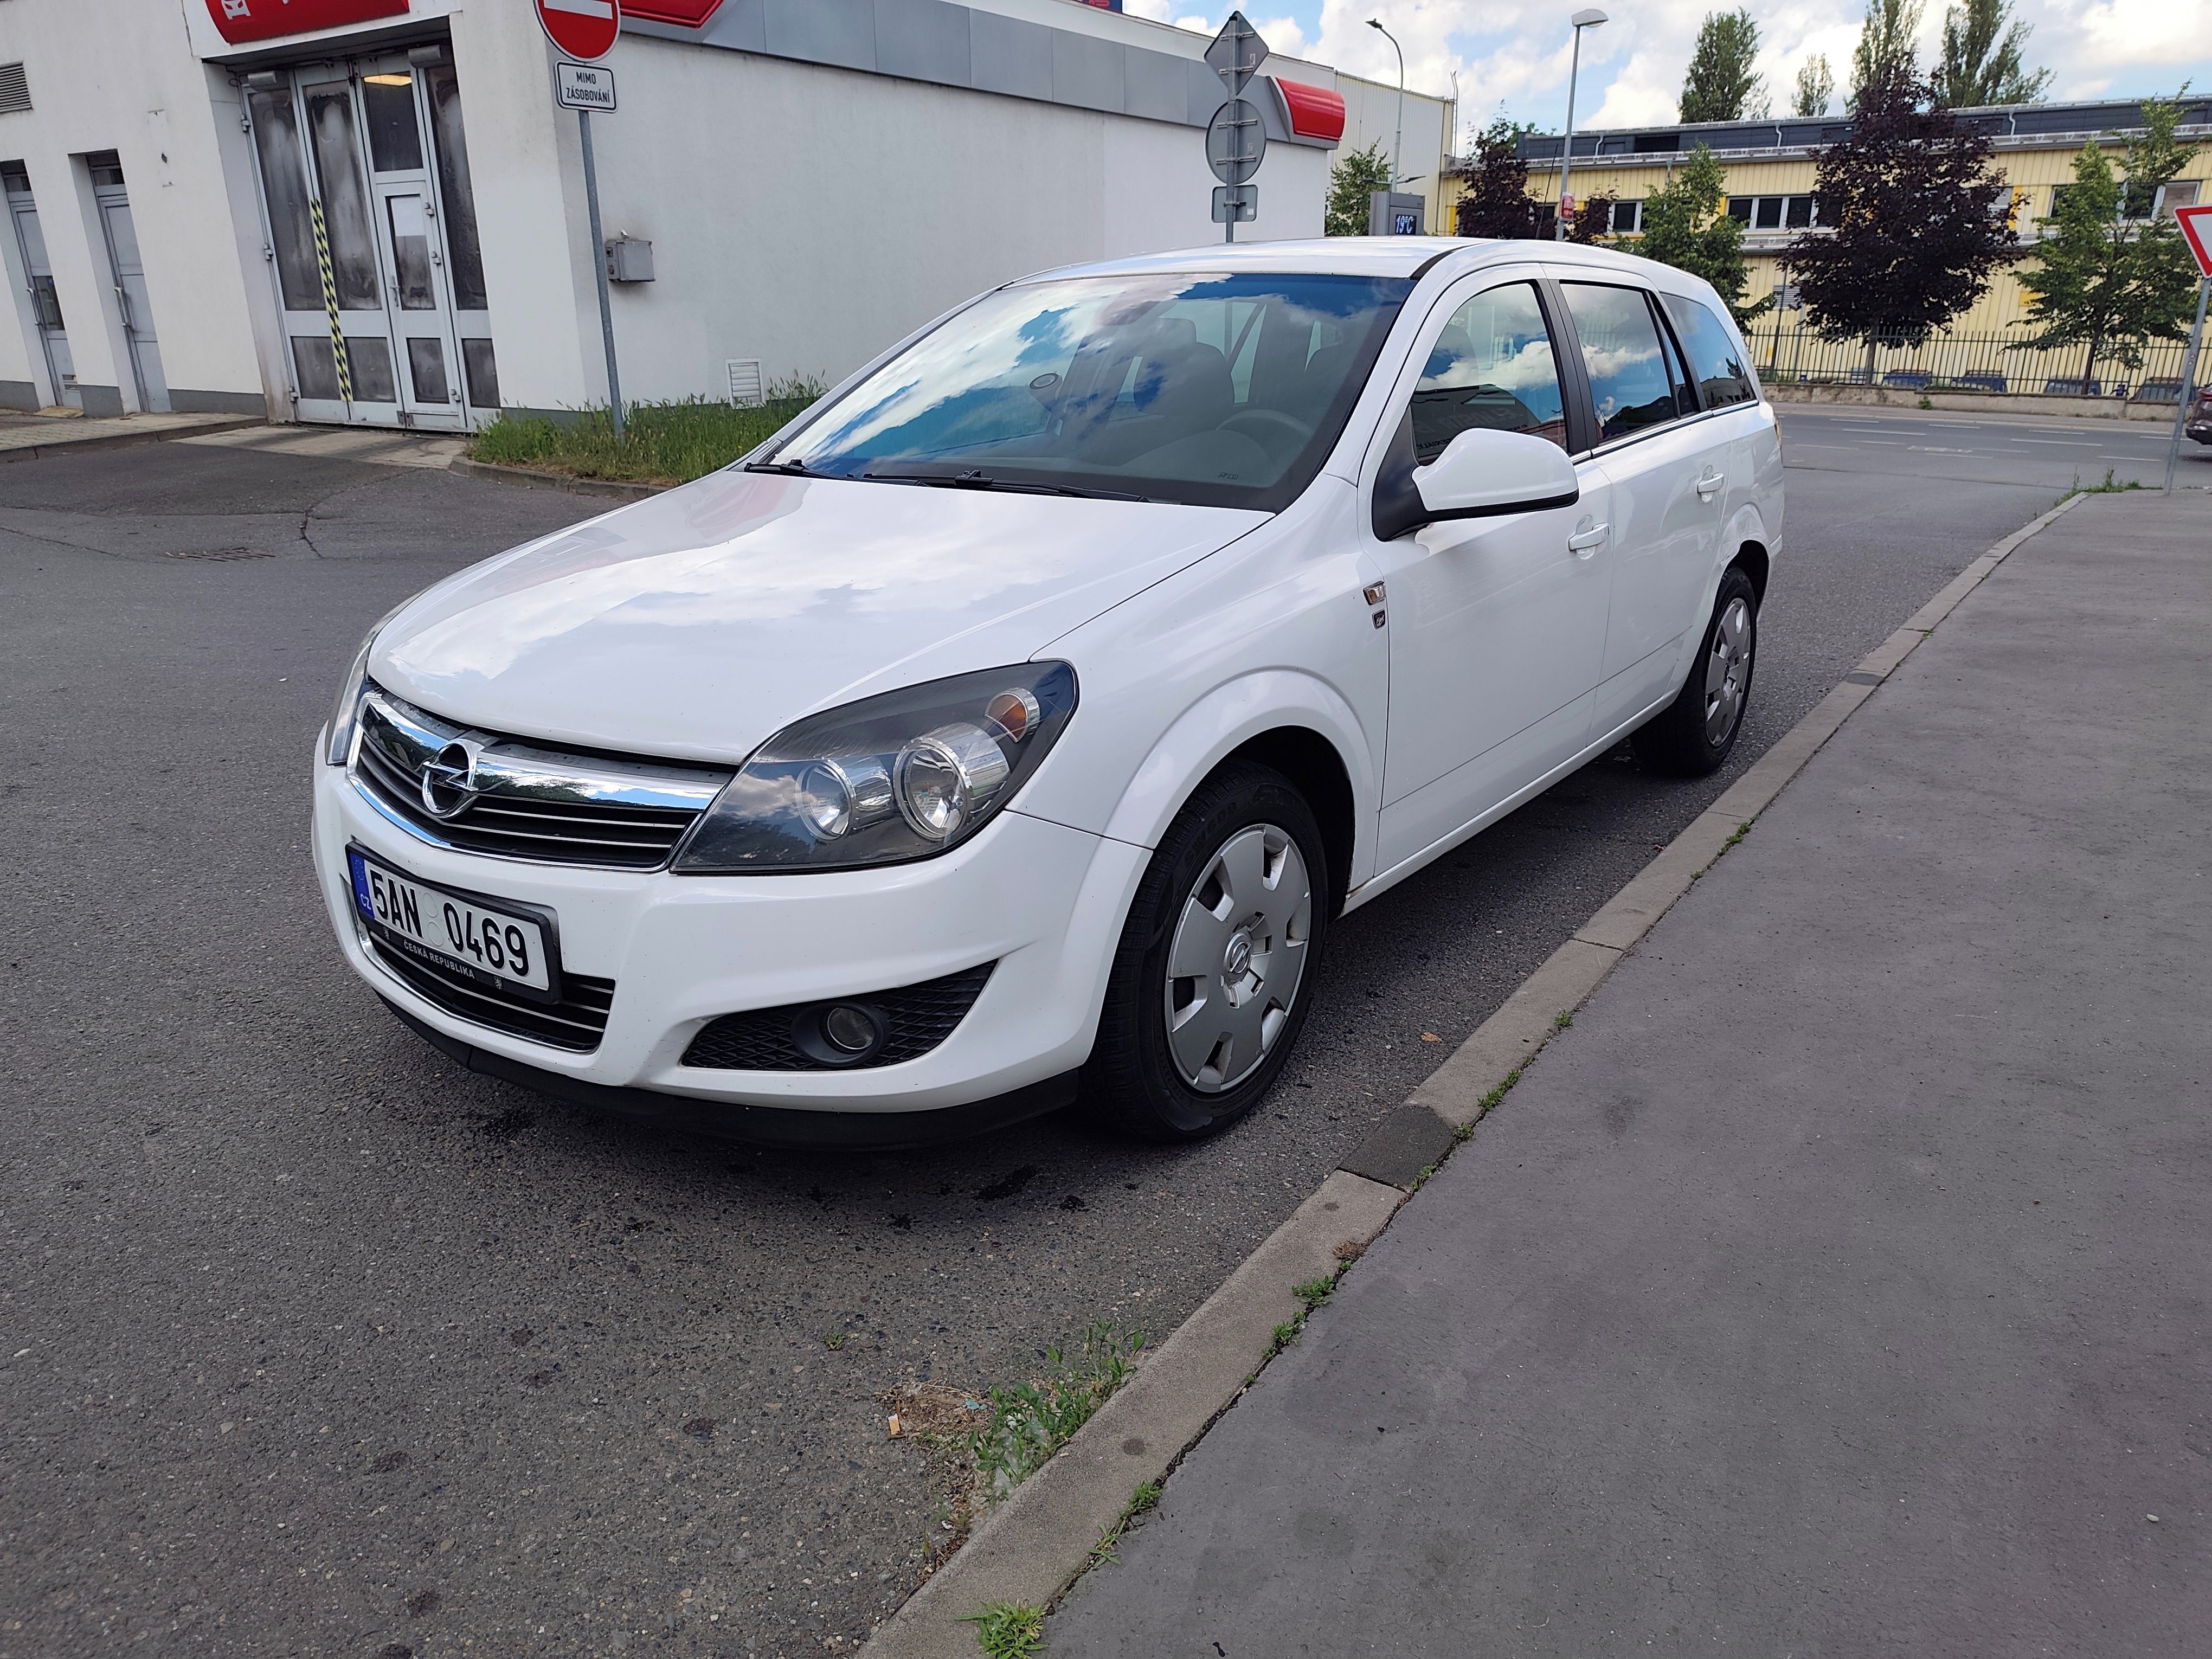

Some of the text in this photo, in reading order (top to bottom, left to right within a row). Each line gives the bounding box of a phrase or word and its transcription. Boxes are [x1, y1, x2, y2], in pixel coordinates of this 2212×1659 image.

[576, 72, 596, 85] MIMO
[566, 85, 610, 103] ZÁSOBOVÁNÍ
[1396, 215, 1414, 234] 19°C
[360, 893, 372, 910] CZ
[370, 869, 530, 976] 5AN 0469
[403, 938, 475, 980] ČESKÁ REPUBLIKA
